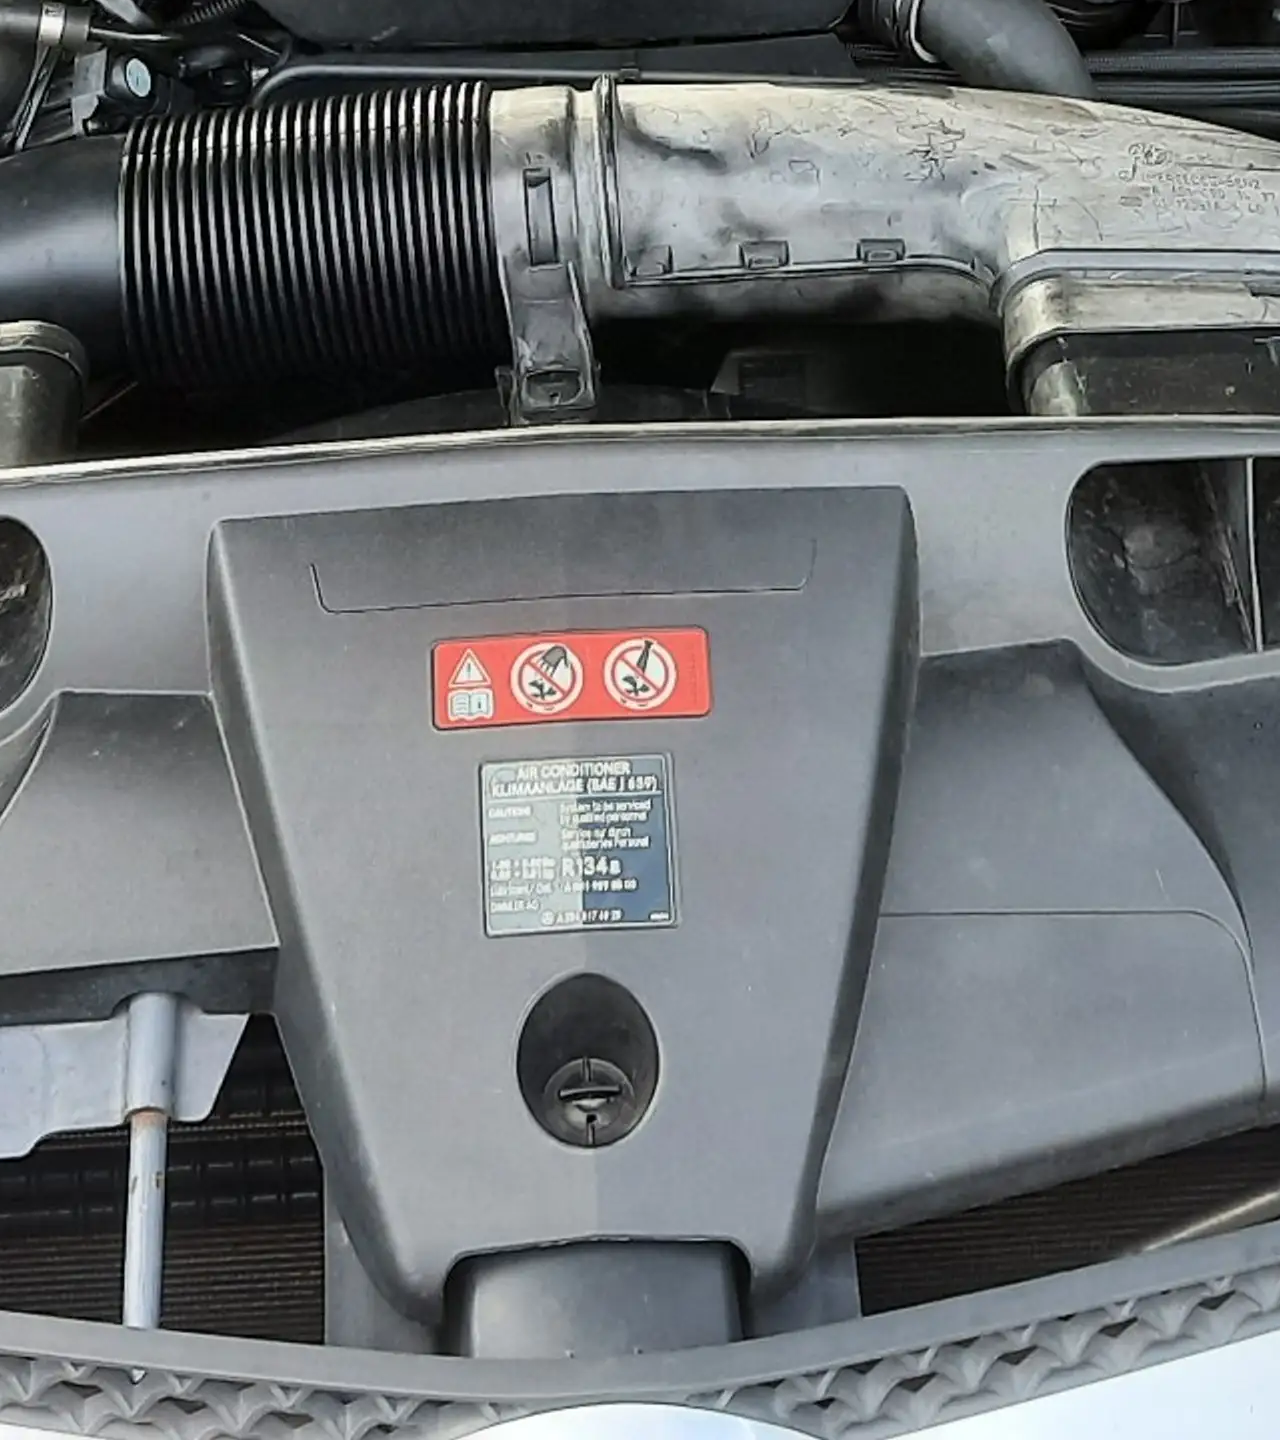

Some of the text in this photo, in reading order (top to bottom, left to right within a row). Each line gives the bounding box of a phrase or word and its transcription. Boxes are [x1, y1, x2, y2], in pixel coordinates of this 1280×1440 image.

[516, 761, 631, 781] AIR CONDITIONER
[492, 777, 585, 797] KLIMAANLAGE
